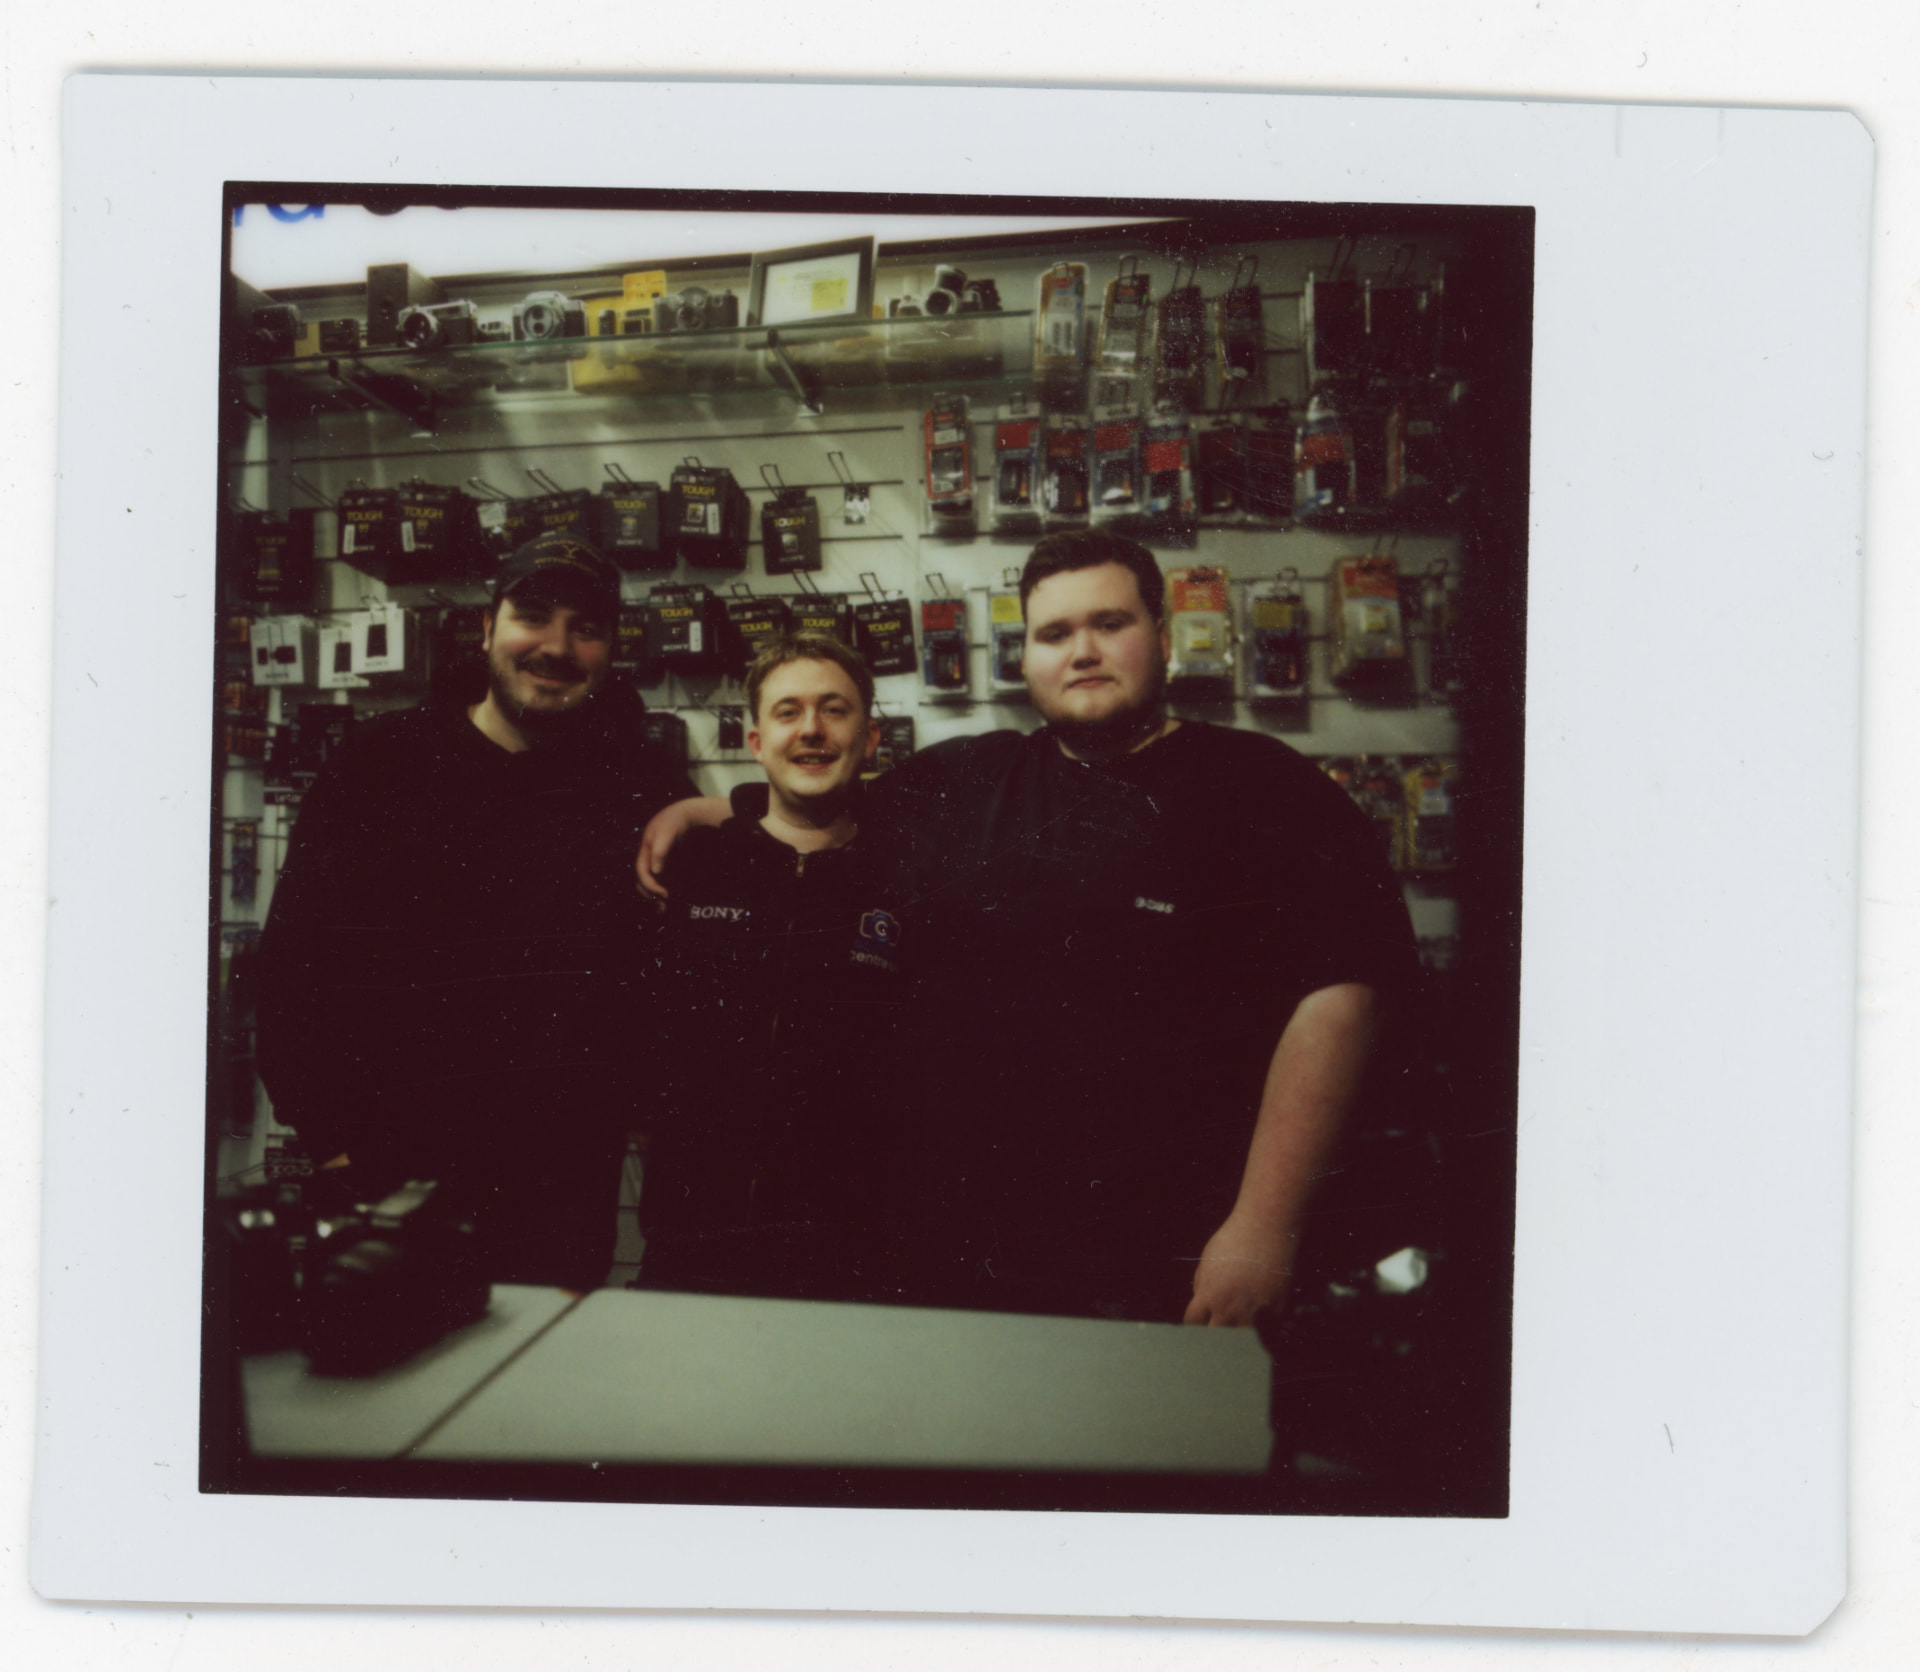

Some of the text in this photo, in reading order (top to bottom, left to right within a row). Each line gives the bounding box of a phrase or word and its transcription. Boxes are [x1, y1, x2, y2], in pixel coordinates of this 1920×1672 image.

[681, 484, 716, 497] TOUGH
[347, 510, 383, 521] TOUGH
[403, 506, 444, 520] TOUGH
[773, 516, 806, 528] TOUGH
[659, 608, 694, 619] TOUGH
[739, 621, 773, 633] TOUGH
[803, 618, 836, 628] TOUGH
[867, 621, 901, 633] TOUGH
[618, 626, 643, 637] OUGH
[690, 905, 745, 921] SONY
